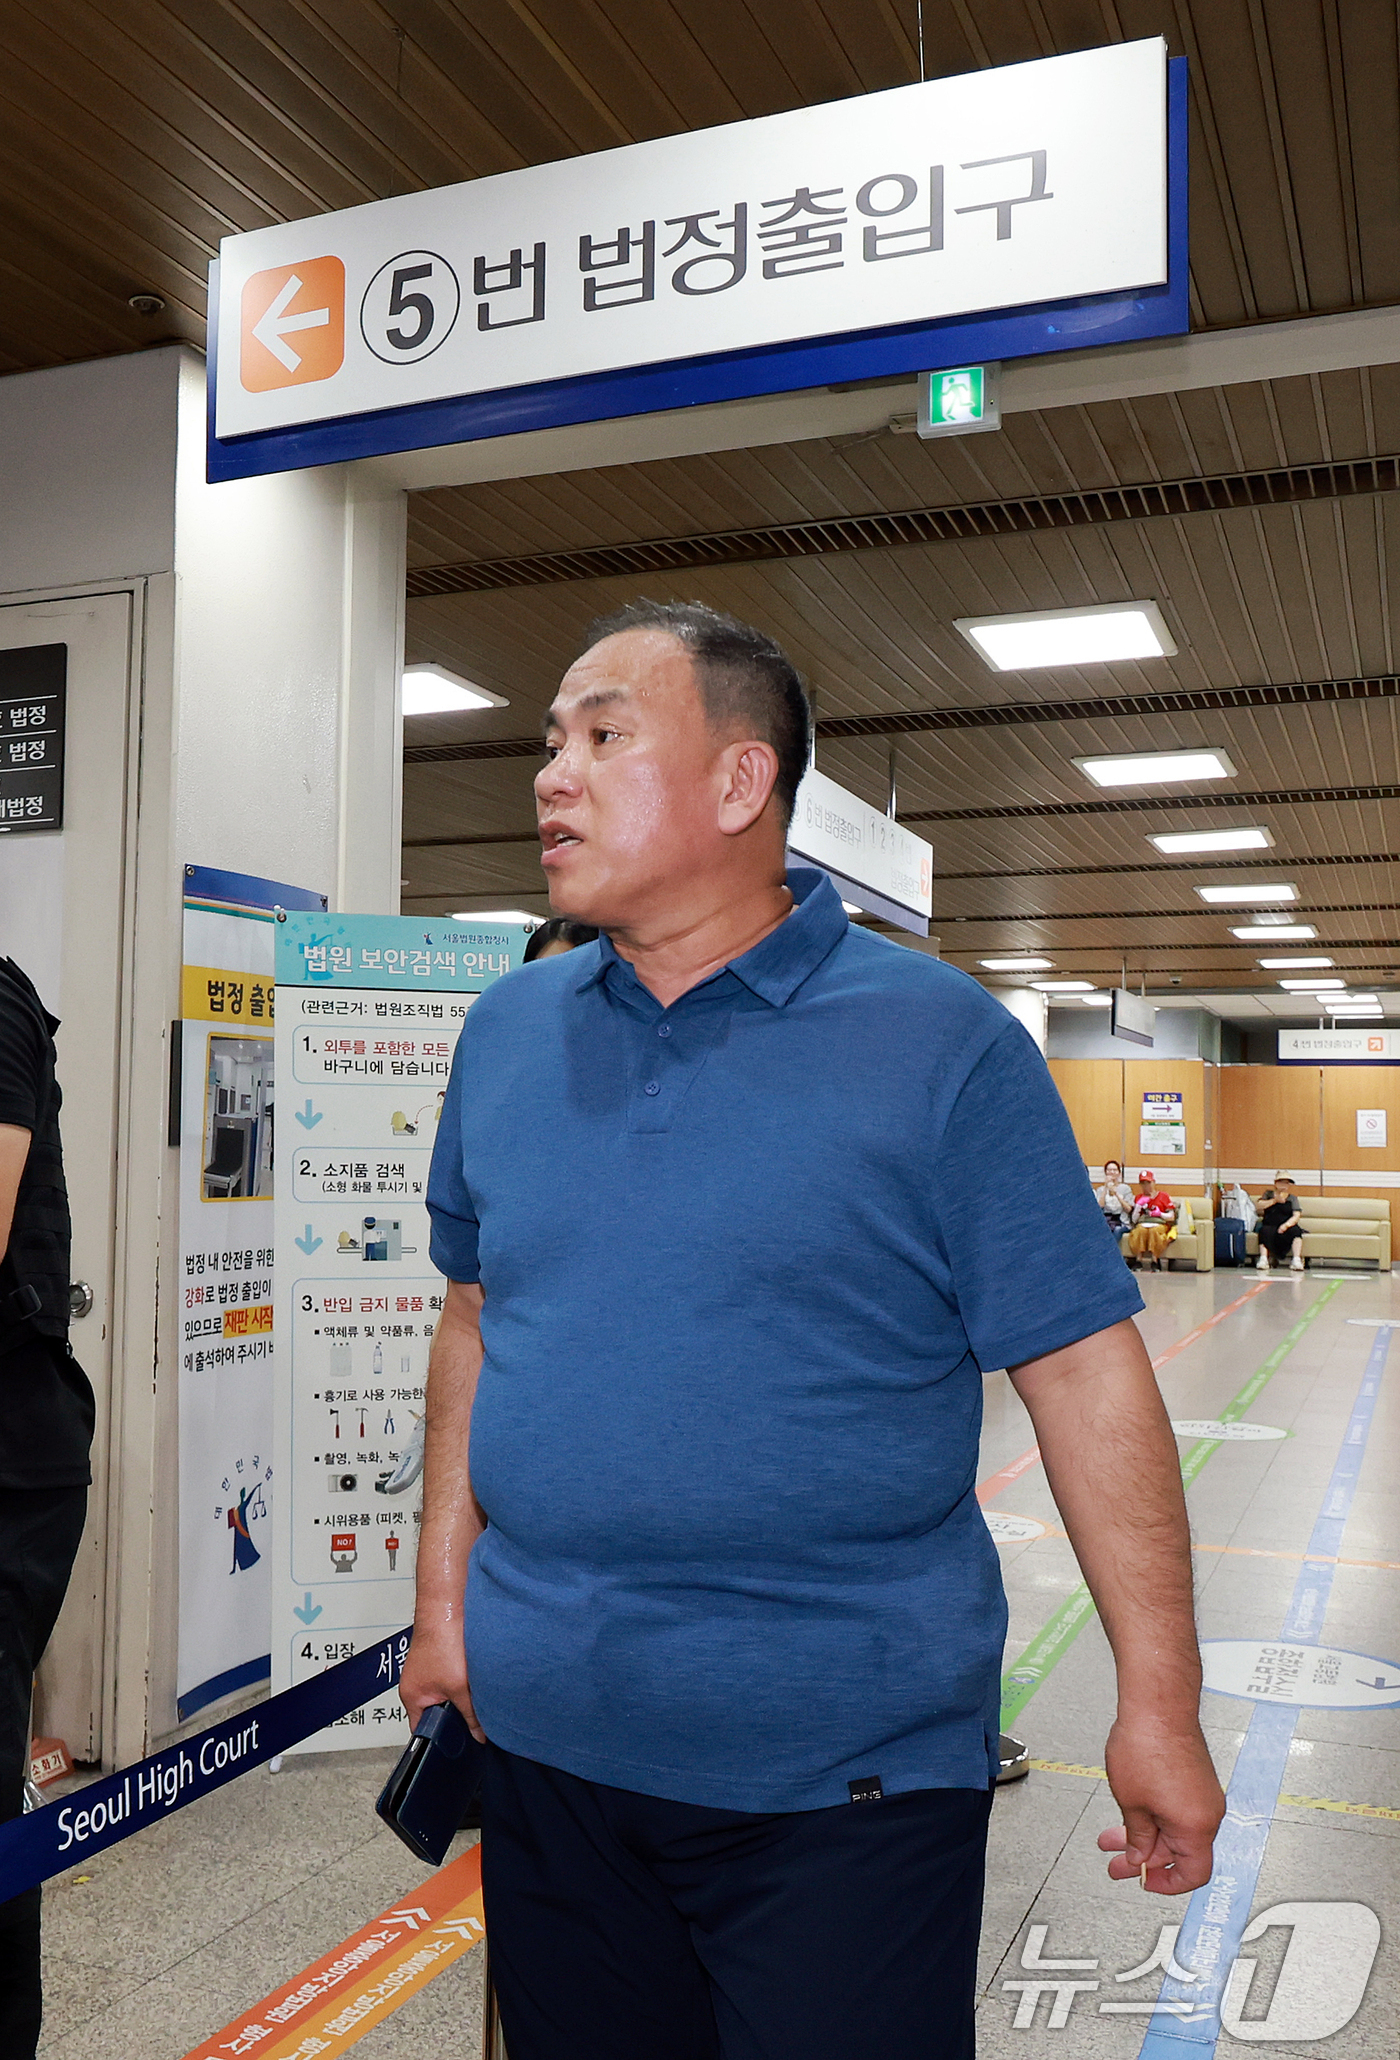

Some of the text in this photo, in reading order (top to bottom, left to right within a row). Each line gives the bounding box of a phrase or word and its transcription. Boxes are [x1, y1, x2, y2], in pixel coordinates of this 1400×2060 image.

[577, 149, 1055, 312] 법정출입구
[10, 705, 46, 728] 법정
[9, 740, 45, 762] 법정
[304, 945, 510, 978] 법원 보안검색 안내
[207, 980, 243, 1015] 법정
[301, 1000, 471, 1017] (관련근거: 법원조직법 55
[303, 1036, 449, 1057] 1. 외투를 포함한 모든
[324, 1059, 449, 1076] 바구니에 담습니다
[300, 1160, 405, 1178] 2. 소지품 검색
[322, 1180, 422, 1193] (소형 화물 투시기 및
[185, 1253, 205, 1275] 법정
[208, 1252, 219, 1271] 내
[222, 1250, 253, 1271] 안전을
[185, 1279, 271, 1308] 강화로 법정 출입이
[302, 1295, 319, 1312] 3.
[323, 1297, 352, 1312] 반입
[359, 1297, 388, 1312] 금지
[395, 1296, 424, 1312] 물품
[185, 1317, 222, 1341] 있으므로
[224, 1309, 249, 1334] 재판
[324, 1324, 434, 1338] 액체류 및 약품류, 음
[195, 1346, 235, 1372] 출석하여
[237, 1340, 266, 1364] 주시기
[324, 1390, 358, 1402] 흉기로
[363, 1389, 385, 1401] 사용
[356, 1452, 383, 1463] 녹화,
[388, 1451, 403, 1462] 녹
[324, 1513, 371, 1527] 시위용품
[376, 1512, 407, 1524] (피켓,
[301, 1642, 355, 1660] 4. 입장
[326, 1709, 364, 1728] 소해
[57, 1719, 259, 1850] Seoul High Court
[852, 1790, 881, 1803] PING
